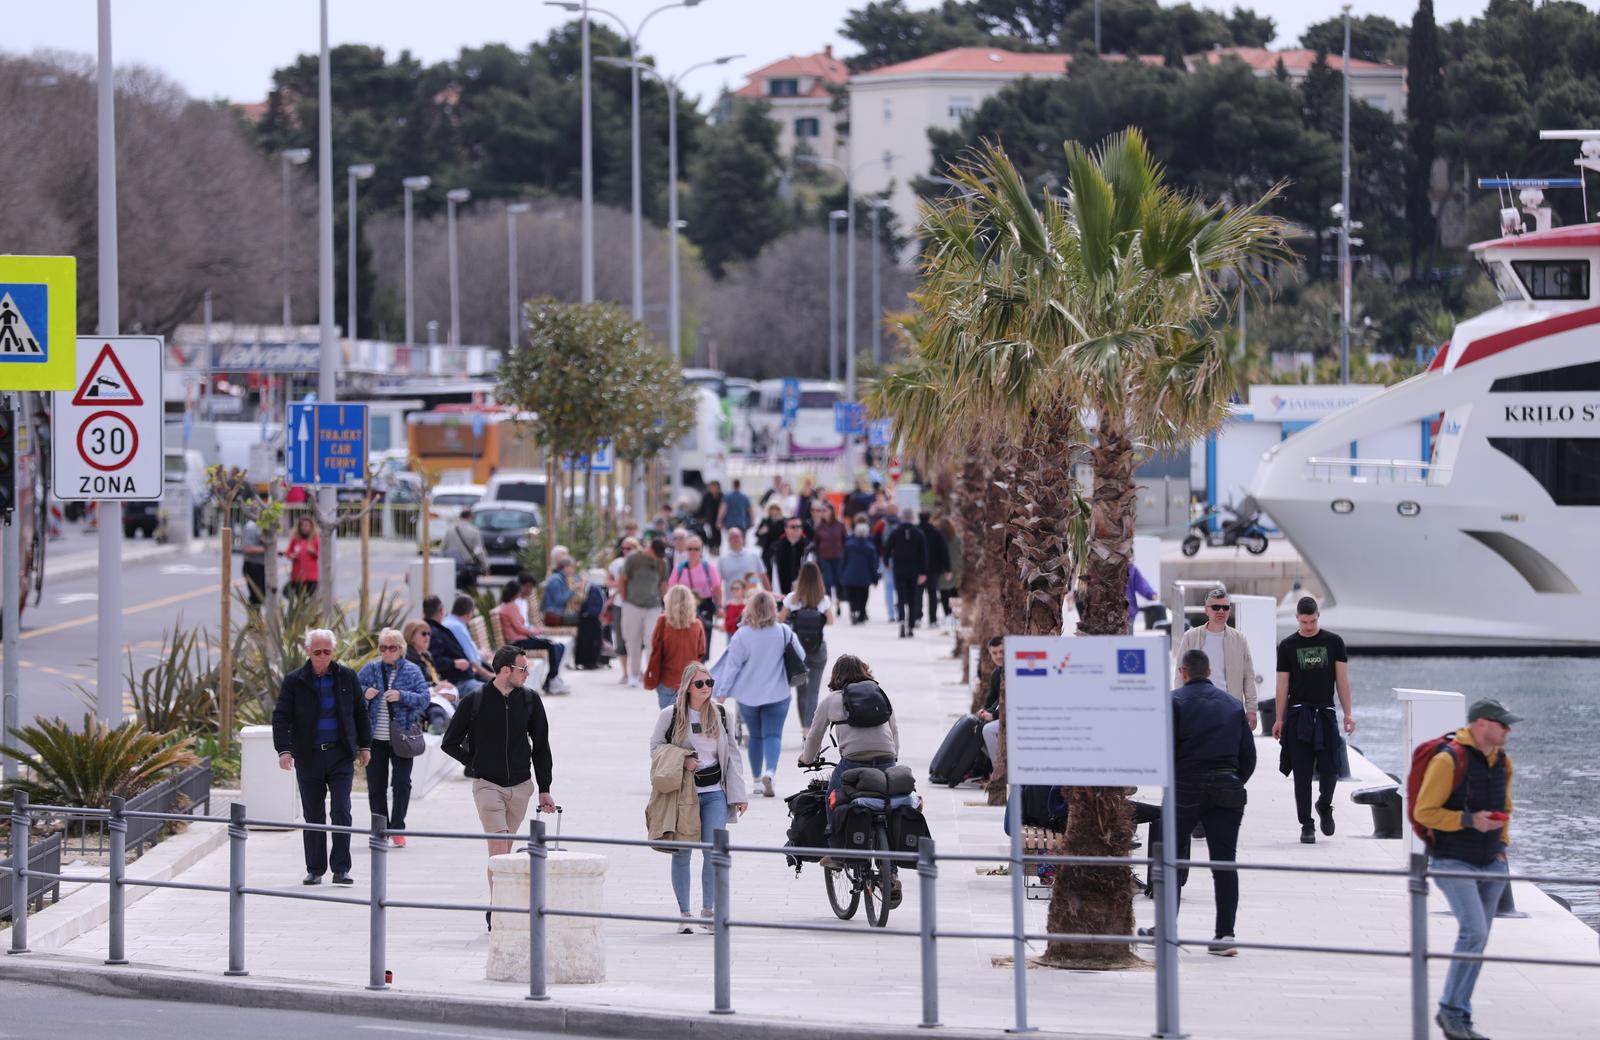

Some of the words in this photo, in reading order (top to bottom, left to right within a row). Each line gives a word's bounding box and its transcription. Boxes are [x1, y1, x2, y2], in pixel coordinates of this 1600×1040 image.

[1505, 404, 1574, 422] KRILO
[91, 427, 125, 455] 30
[320, 430, 362, 441] TRAJEKT
[331, 443, 352, 455] CAR
[324, 457, 357, 469] FERRY
[79, 476, 136, 493] ZONA
[1304, 656, 1322, 664] HUGO
